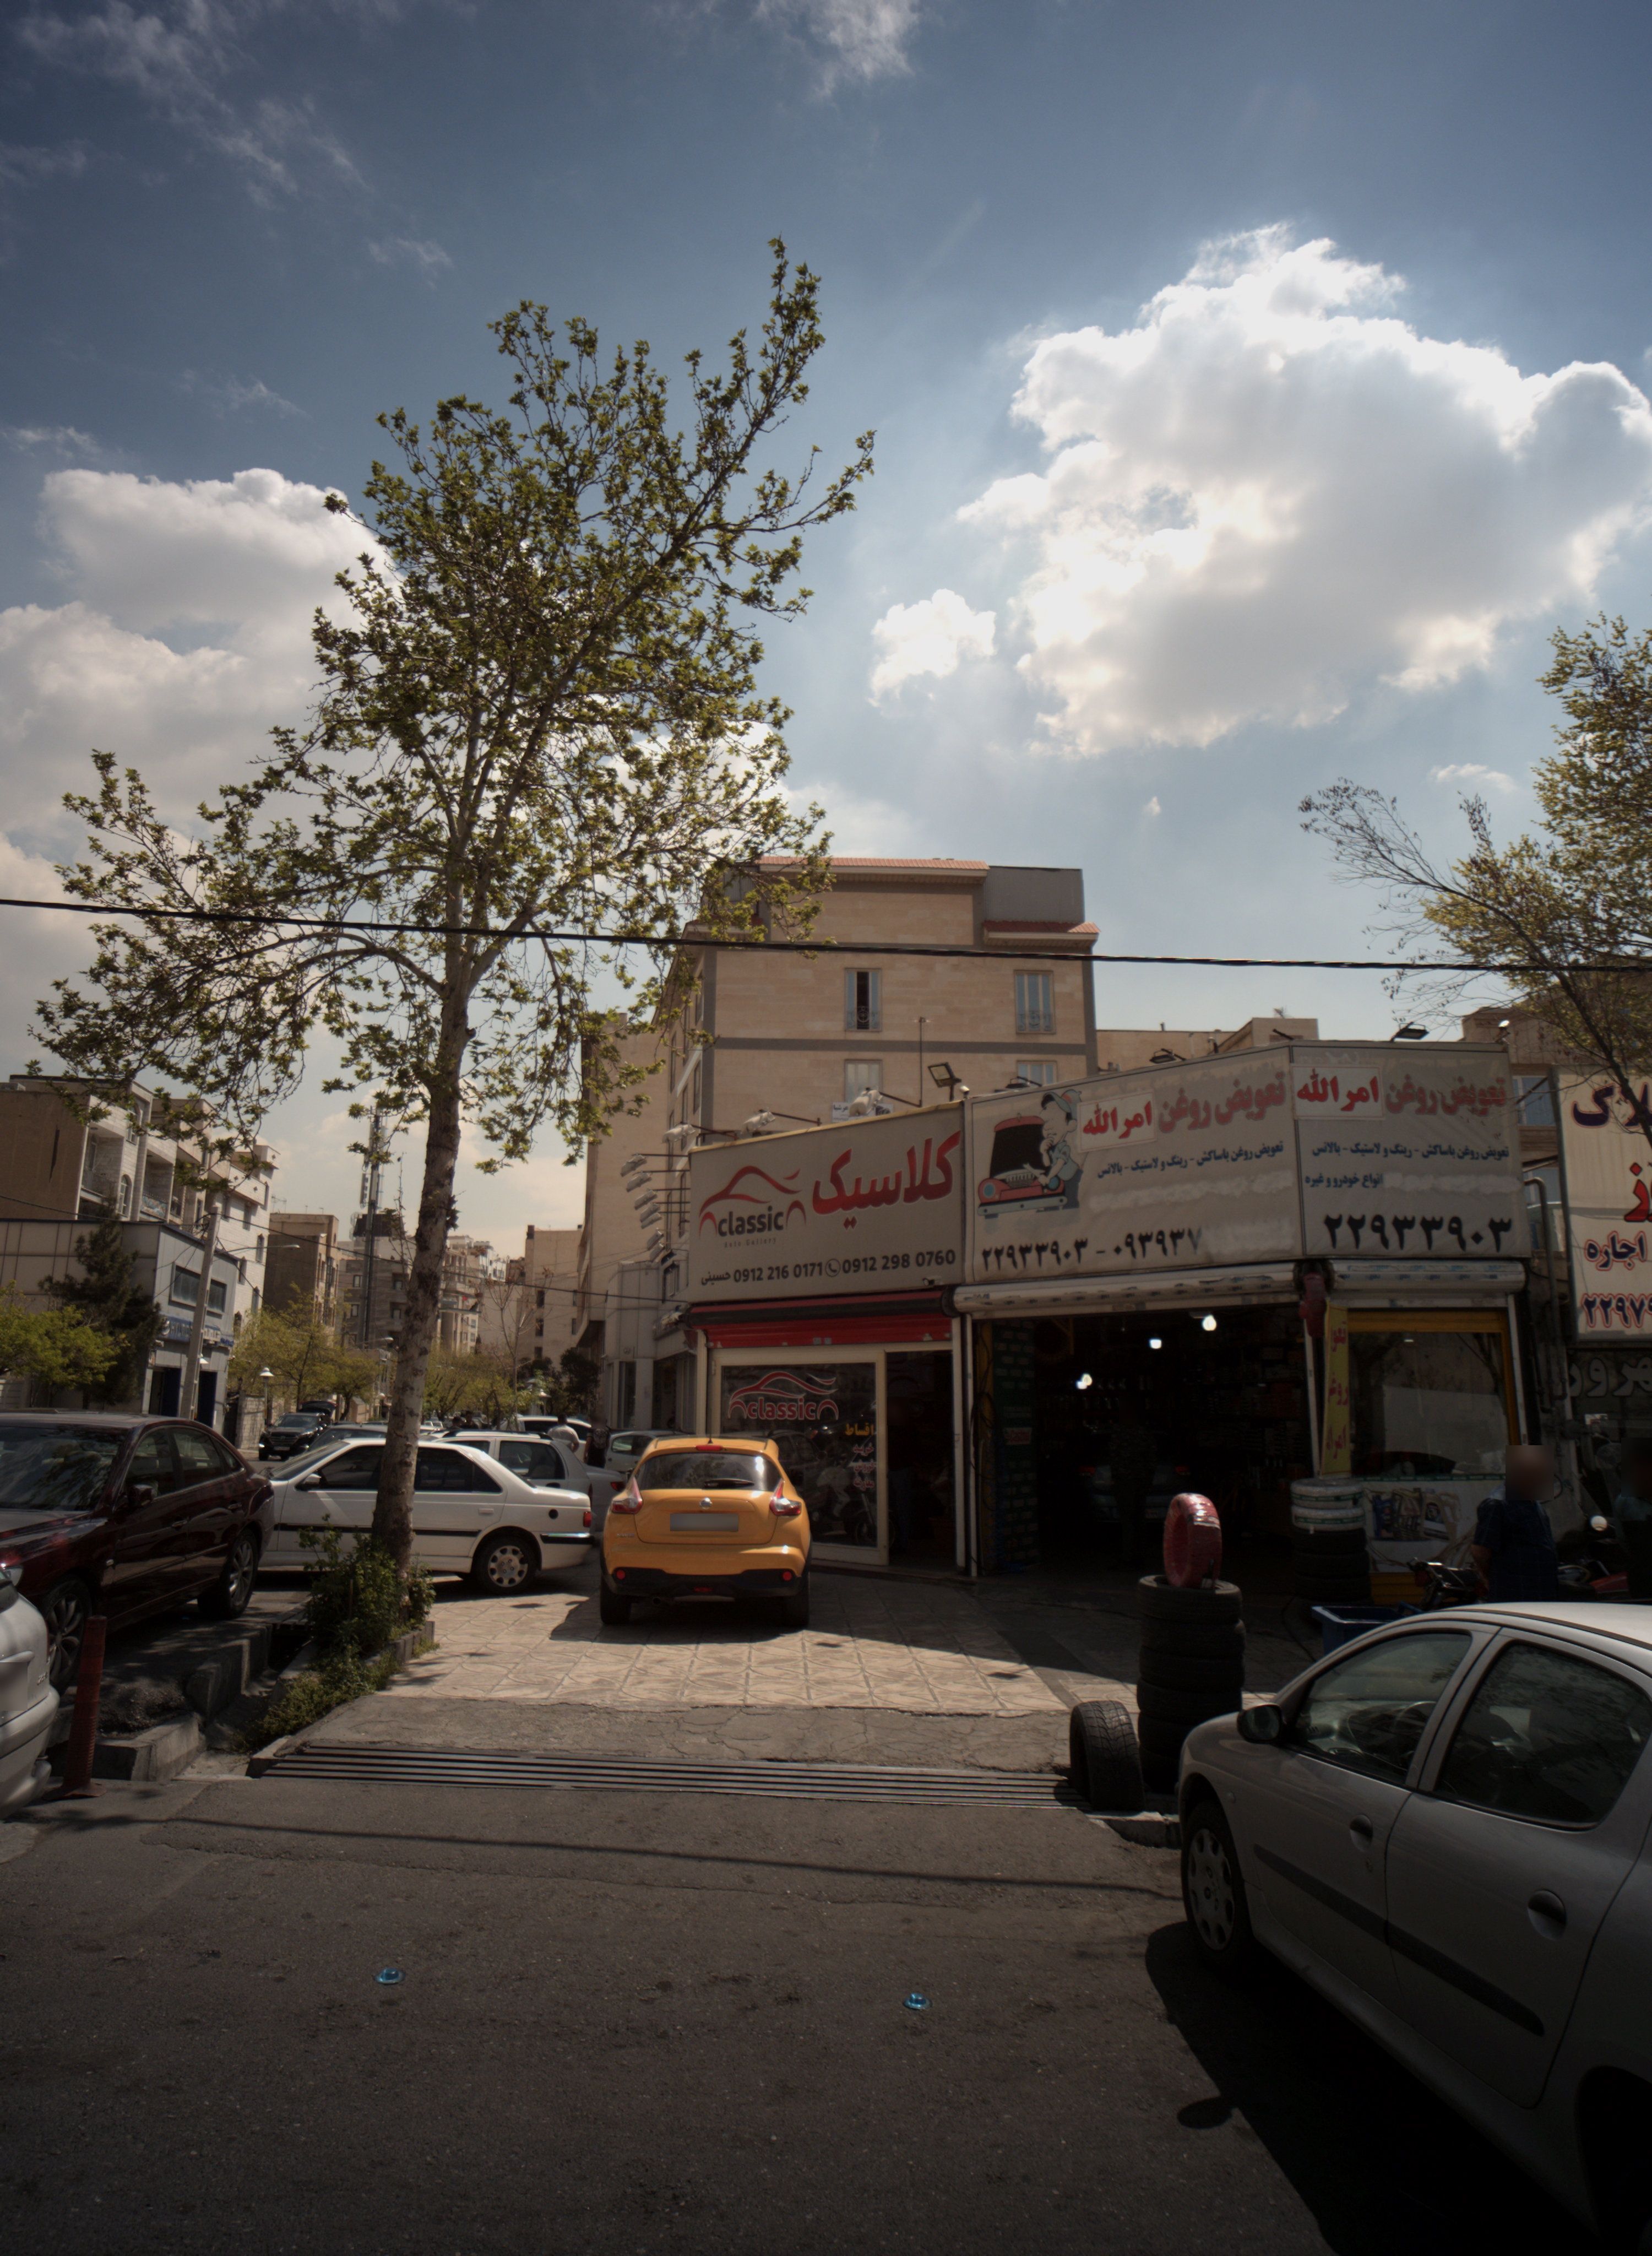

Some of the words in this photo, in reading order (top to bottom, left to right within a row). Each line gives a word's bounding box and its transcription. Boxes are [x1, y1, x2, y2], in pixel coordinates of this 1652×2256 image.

[1159, 1087, 1212, 1134] روغن
[1215, 1071, 1286, 1125] تعویض
[1385, 1073, 1439, 1115] روغن
[1441, 1076, 1507, 1116] تعویض
[812, 1130, 961, 1230] کلاسیک
[718, 1206, 784, 1237] classic
[1324, 1213, 1512, 1253] ۲۲۹۳۳۹۰۳
[746, 1238, 776, 1246] Gallery
[982, 1238, 1088, 1271] ۲۲۹۳۳۹۰۳
[1586, 1233, 1646, 1269] اجاره
[701, 1272, 731, 1286] حسینی
[733, 1267, 764, 1283] 0912
[767, 1265, 789, 1280] 216
[793, 1262, 823, 1278] 0171
[843, 1256, 877, 1273] 0912
[882, 1254, 910, 1270] 298
[916, 1249, 955, 1267] 0760
[748, 1397, 817, 1420] classic
